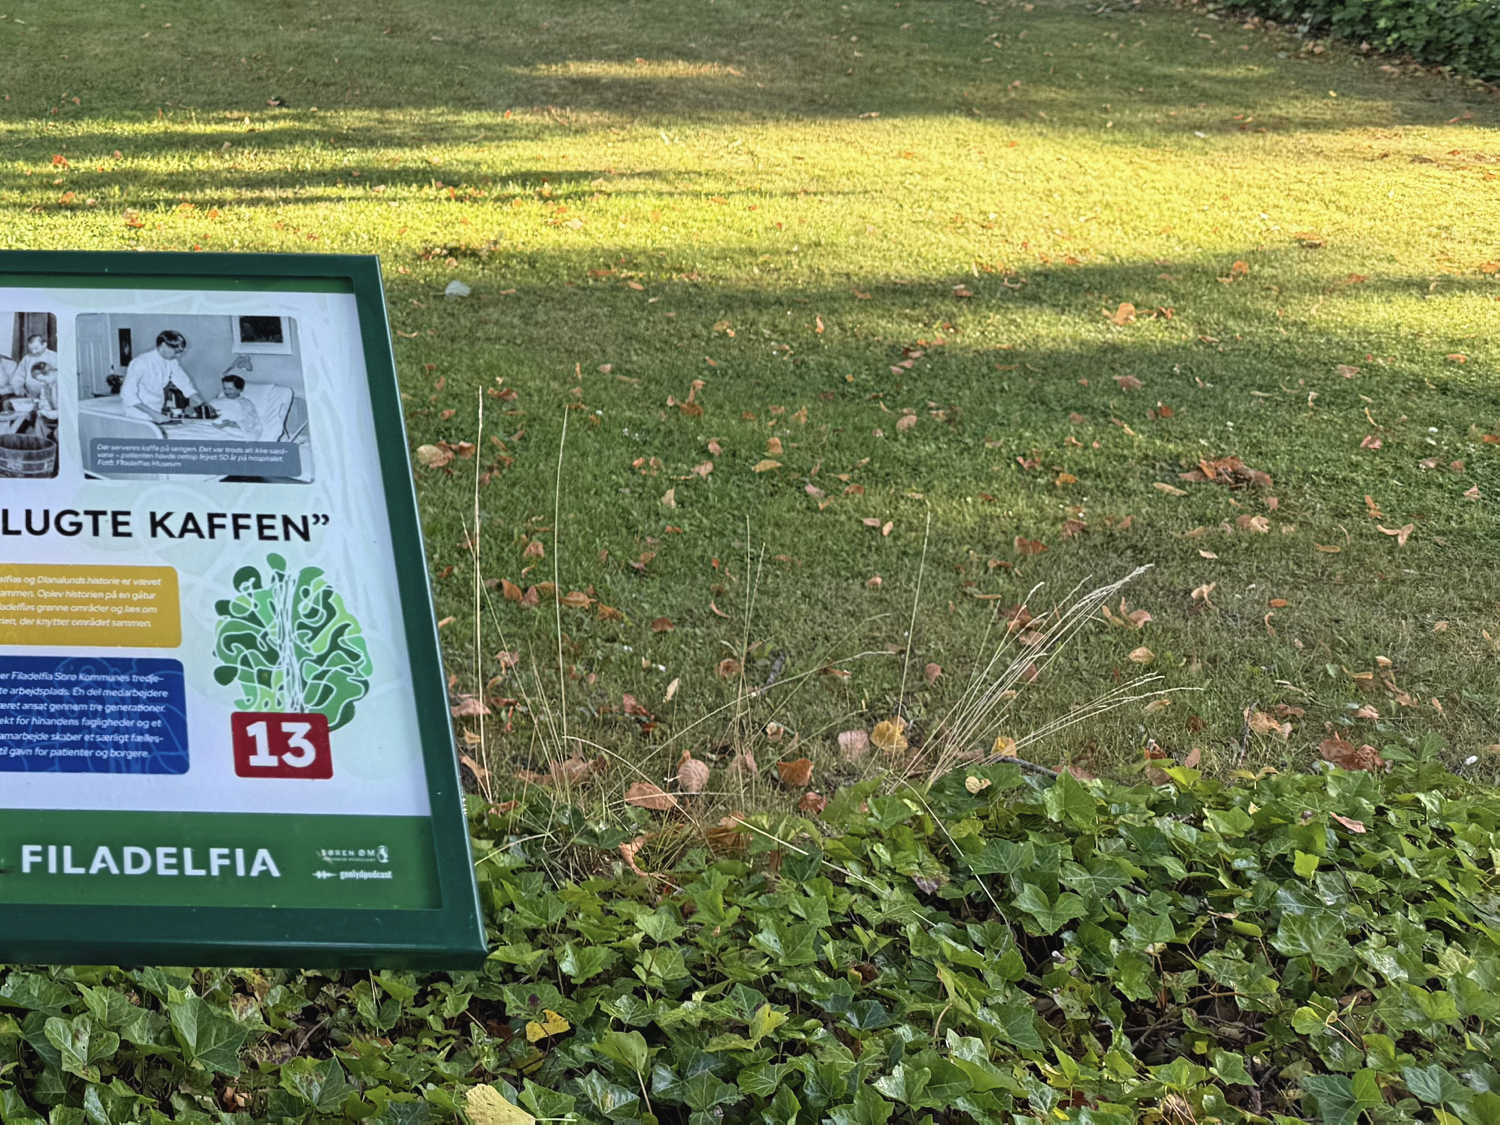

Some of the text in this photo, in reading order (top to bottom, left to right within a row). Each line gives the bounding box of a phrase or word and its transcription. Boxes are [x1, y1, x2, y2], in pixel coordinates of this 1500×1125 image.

[1, 507, 133, 538] LUGTE
[10, 671, 52, 681] Filadelfia
[54, 672, 76, 682] Sorø
[78, 673, 129, 682] Kommunes
[131, 673, 164, 686] tredje-
[71, 687, 84, 696] En
[86, 687, 101, 697] del
[102, 688, 168, 700] medarbejdere
[21, 702, 46, 711] ansat
[48, 704, 87, 714] gennem
[89, 703, 103, 712] tre
[104, 703, 165, 715] generationer.
[15, 716, 29, 726] for
[30, 717, 79, 726] hinandens
[81, 717, 134, 730] fagligheder
[135, 720, 149, 730] og
[150, 719, 161, 728] et
[50, 732, 81, 742] skaber
[83, 733, 94, 742] et
[95, 733, 128, 745] særligt
[130, 733, 164, 743] fælles-
[245, 720, 317, 768] 13
[8, 749, 32, 759] gavn
[34, 747, 47, 757] for
[49, 748, 92, 760] patienter
[94, 750, 108, 760] og
[109, 748, 150, 760] borgere.
[20, 844, 282, 878] FILADELFIA
